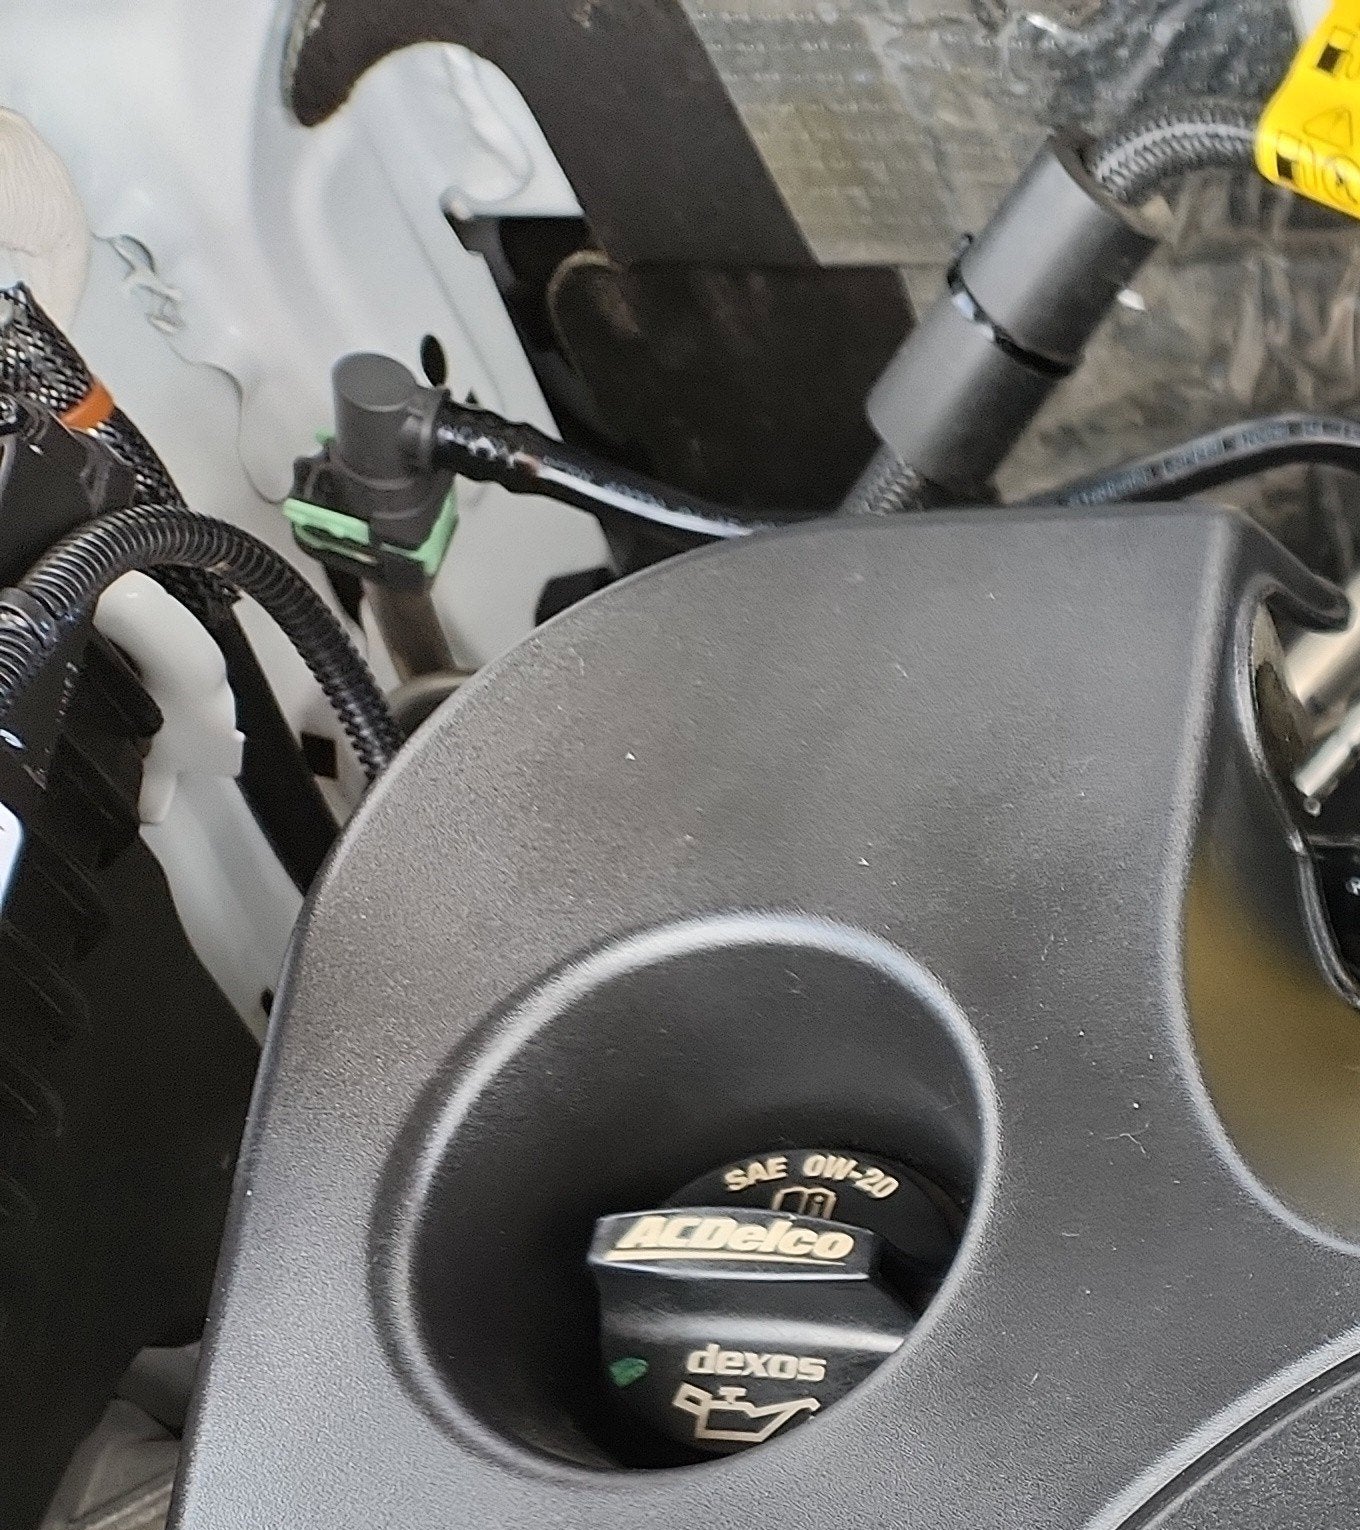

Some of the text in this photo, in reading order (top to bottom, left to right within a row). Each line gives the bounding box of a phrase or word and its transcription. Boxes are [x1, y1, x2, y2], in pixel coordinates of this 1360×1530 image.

[724, 1154, 900, 1199] SAE 0W-20
[615, 1215, 855, 1259] ACDelco
[686, 1343, 828, 1382] dexos
